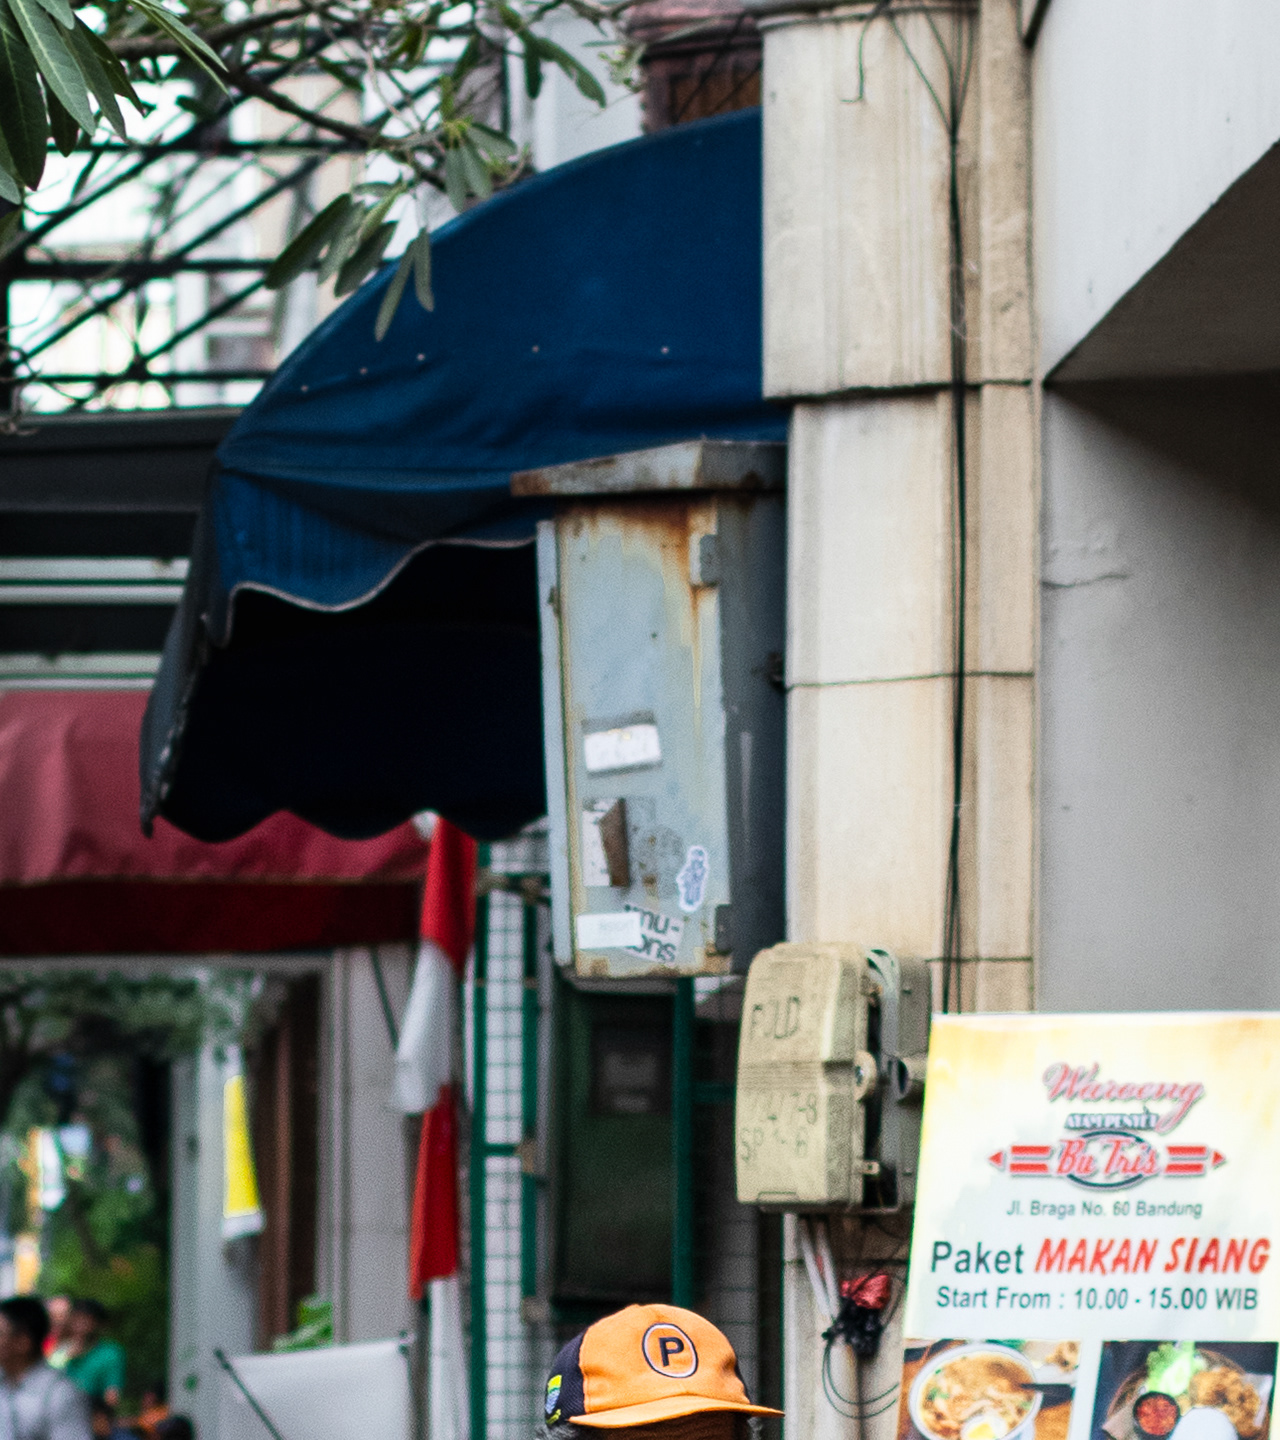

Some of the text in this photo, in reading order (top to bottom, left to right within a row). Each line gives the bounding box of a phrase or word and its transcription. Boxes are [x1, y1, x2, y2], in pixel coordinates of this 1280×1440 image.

[1057, 1137, 1158, 1175] Bu Tris
[1007, 1200, 1202, 1220] Jl. Braga No. 60 Bandung
[930, 1237, 1271, 1275] Paket MAKAN SIANG
[936, 1286, 987, 1308] Start
[996, 1286, 1051, 1309] From
[1075, 1287, 1129, 1310] 10.00
[1148, 1286, 1208, 1310] 15.00
[1215, 1288, 1258, 1310] WIB
[659, 1337, 685, 1367] P
